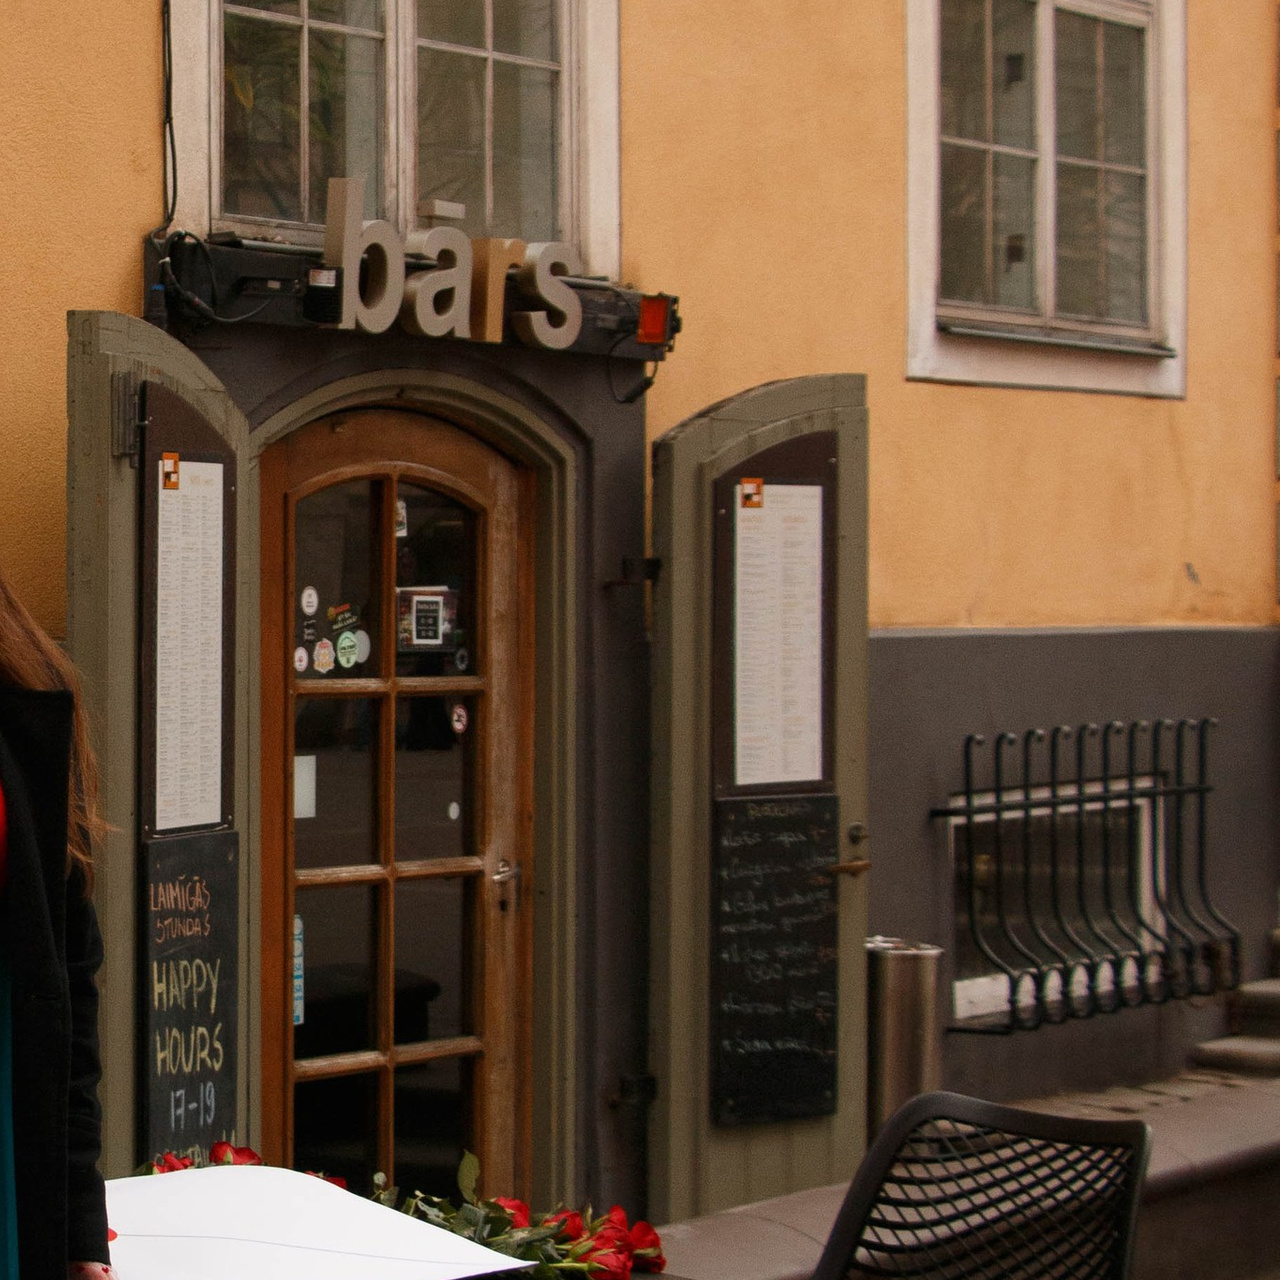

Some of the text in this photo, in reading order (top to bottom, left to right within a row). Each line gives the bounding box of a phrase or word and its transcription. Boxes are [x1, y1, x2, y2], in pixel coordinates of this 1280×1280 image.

[326, 177, 583, 350] bārs
[150, 874, 211, 912] LAIMĪGĀS
[155, 913, 211, 943] STUNDAS
[152, 958, 220, 1015] HAPPY
[155, 1022, 224, 1077] HOURS
[170, 1080, 215, 1131] 17-19
